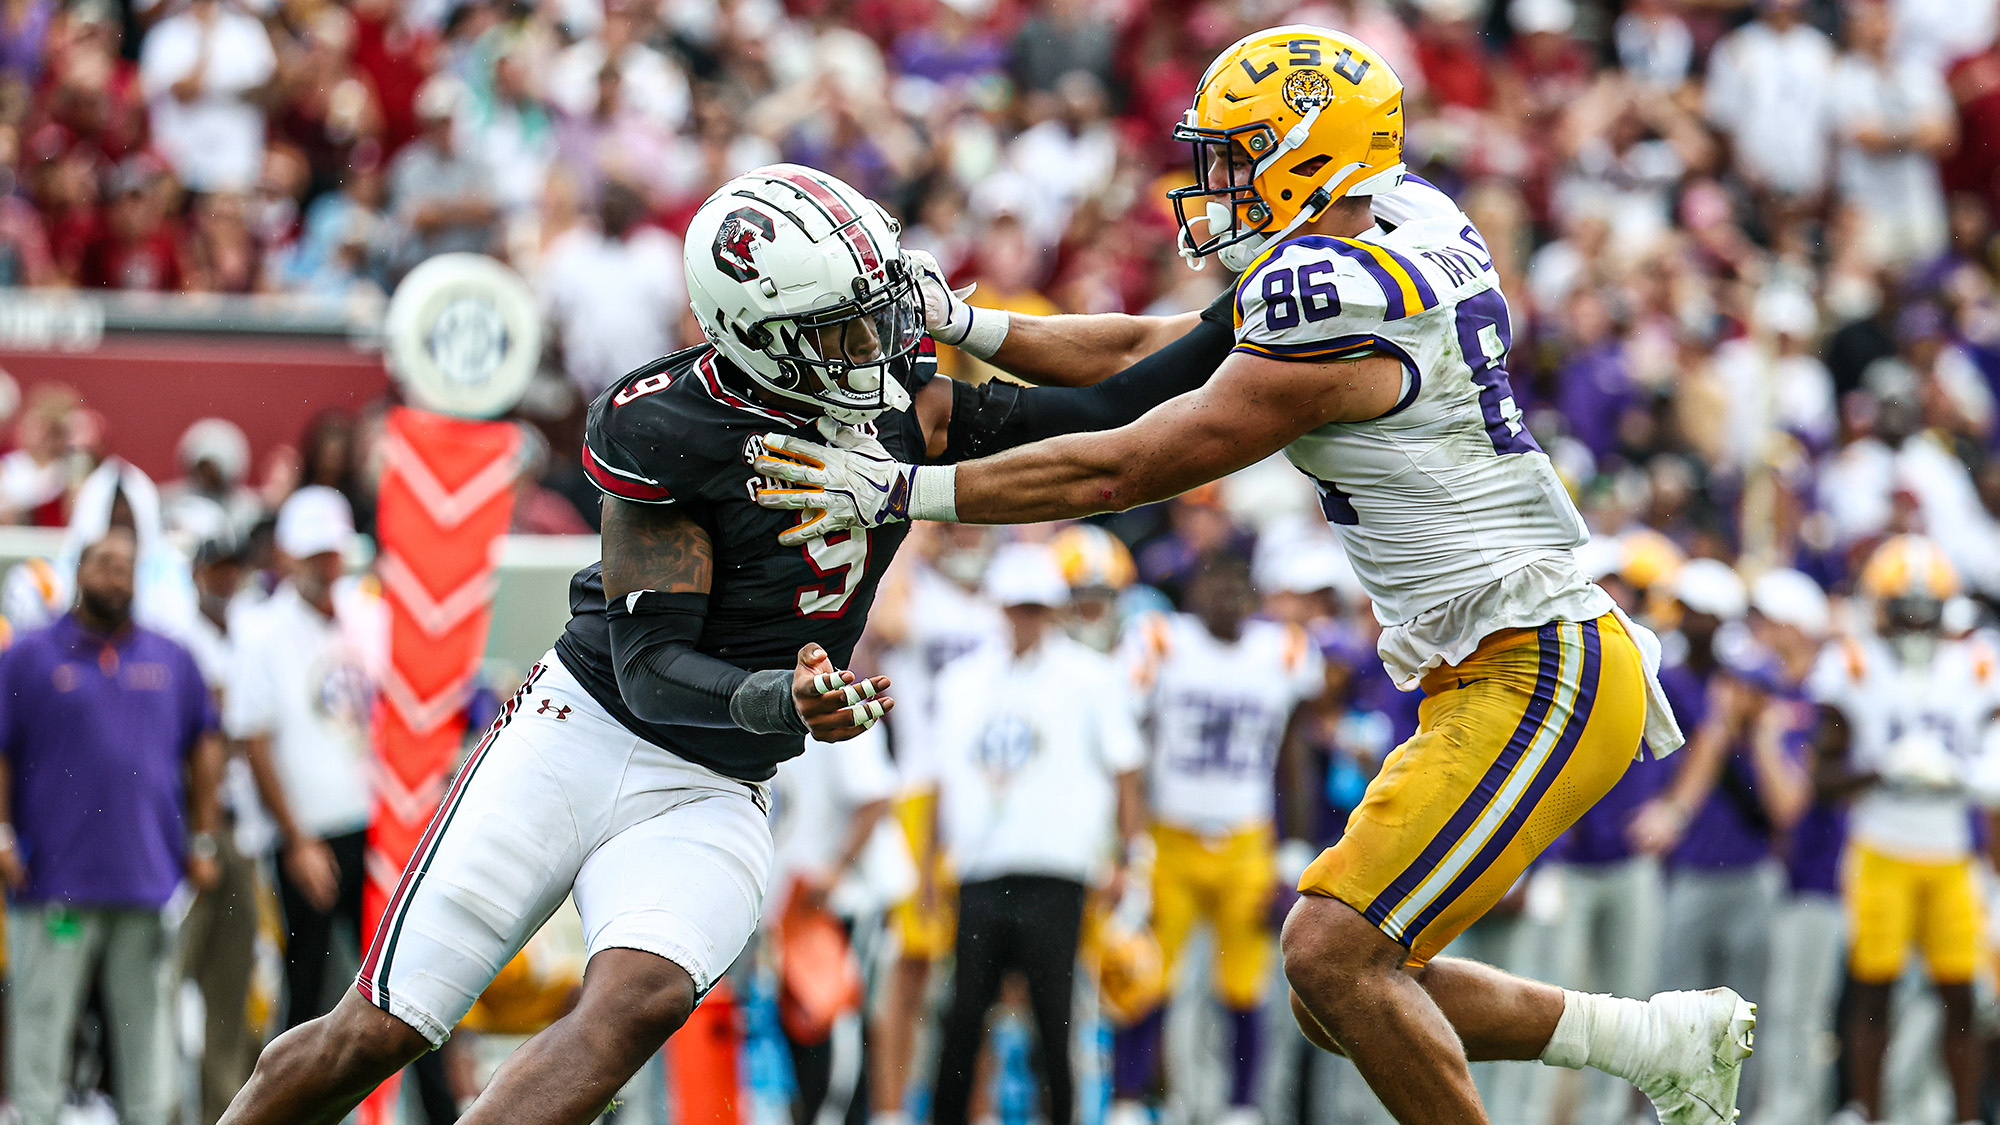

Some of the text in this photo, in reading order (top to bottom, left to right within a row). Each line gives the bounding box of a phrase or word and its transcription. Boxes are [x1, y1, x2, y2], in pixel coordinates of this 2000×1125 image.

[1239, 39, 1371, 85] LSU
[1262, 260, 1341, 331] 86
[612, 371, 673, 408] 9
[792, 508, 873, 619] 9
